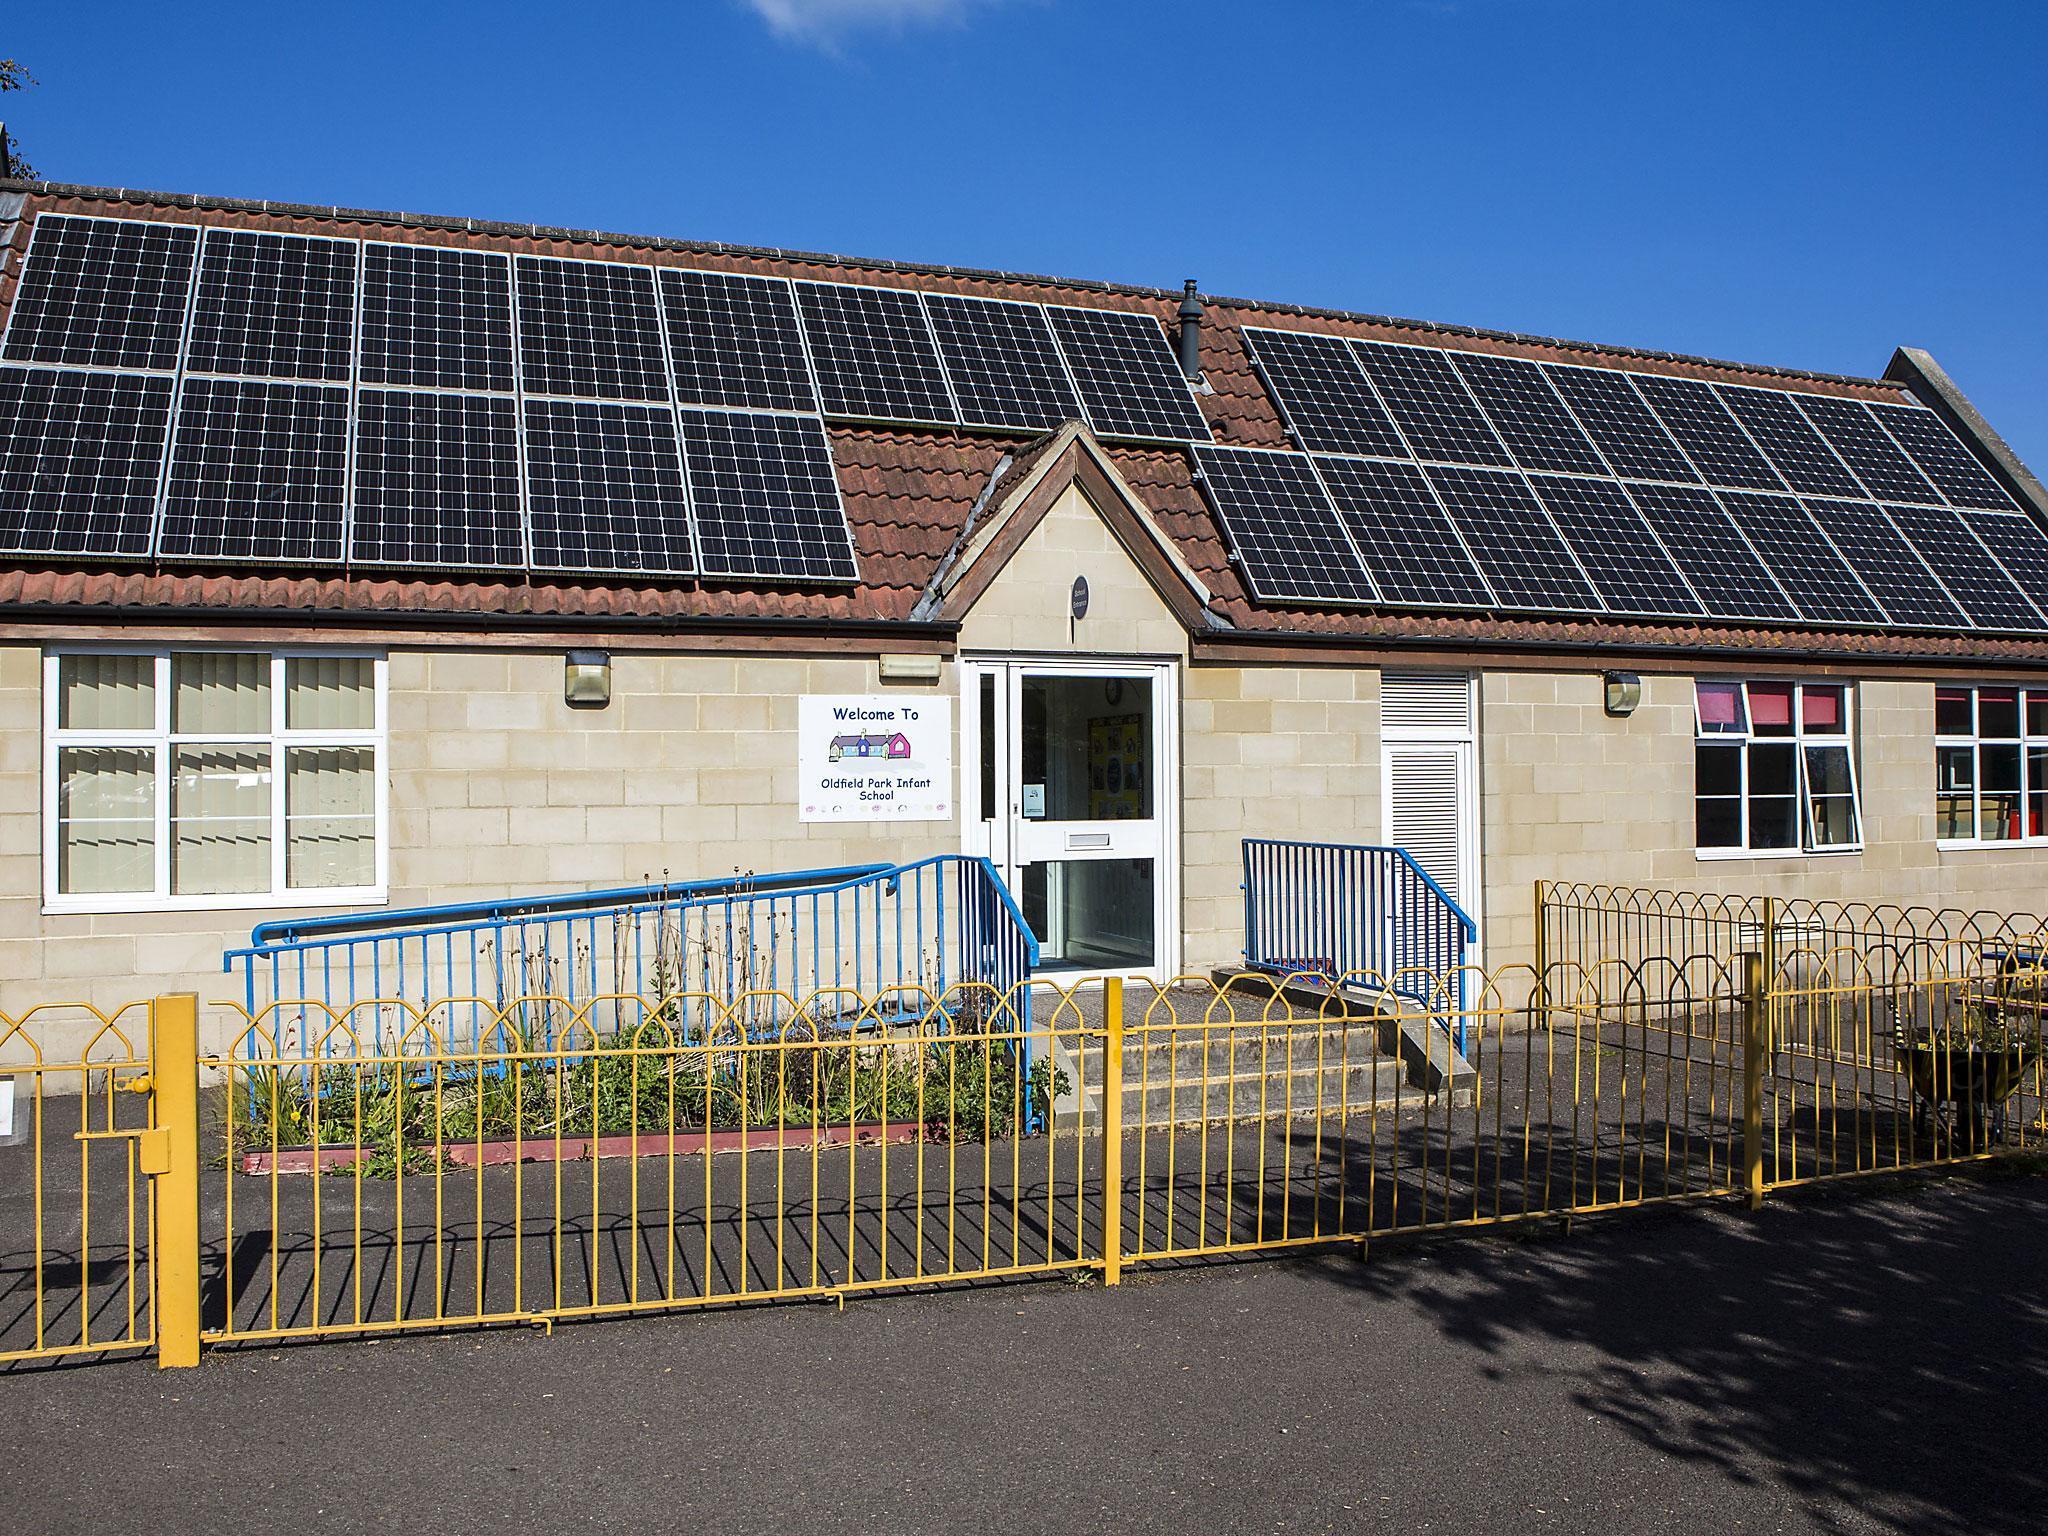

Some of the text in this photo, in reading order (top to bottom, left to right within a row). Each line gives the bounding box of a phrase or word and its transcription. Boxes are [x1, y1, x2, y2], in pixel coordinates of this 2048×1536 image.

[833, 707, 919, 721] Welcome To
[821, 778, 931, 789] Oldfield Park Infant
[859, 791, 894, 801] School
